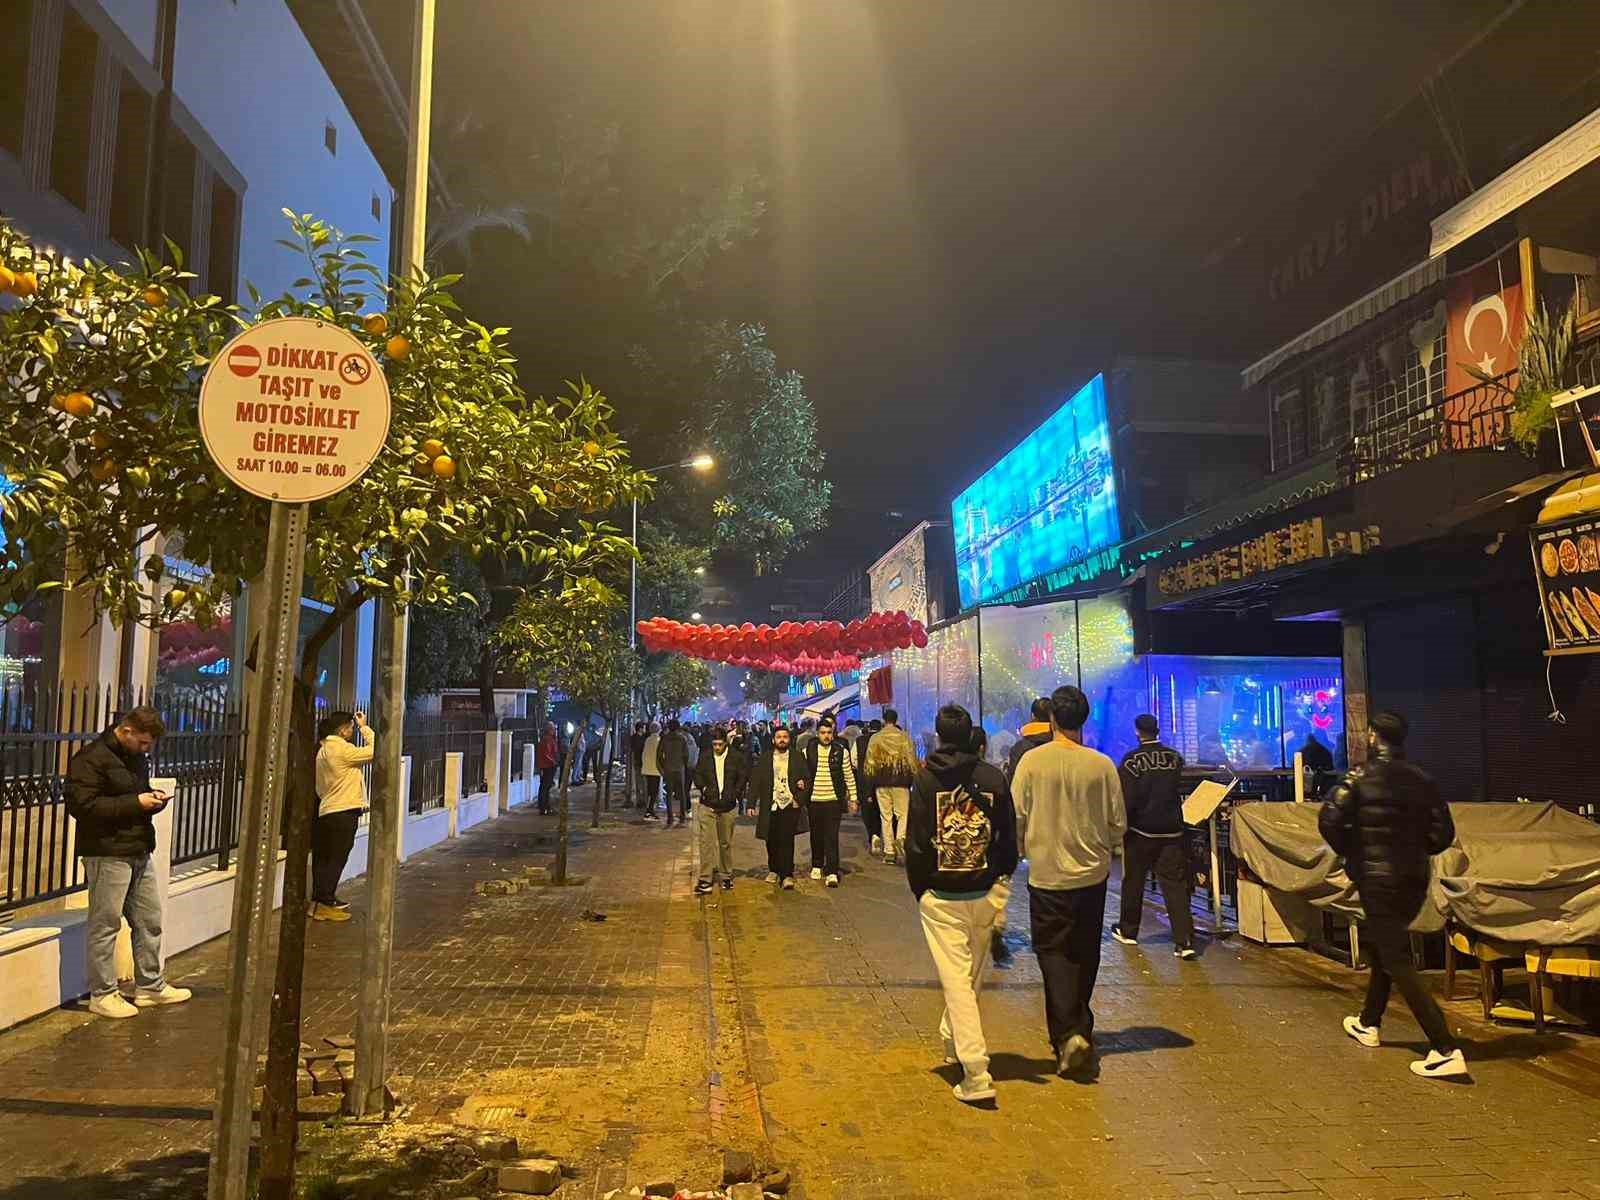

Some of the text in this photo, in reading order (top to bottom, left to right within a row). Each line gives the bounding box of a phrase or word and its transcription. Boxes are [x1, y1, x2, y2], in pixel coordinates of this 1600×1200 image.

[267, 343, 338, 371] DİKKAT
[258, 374, 341, 401] TAŞIT ve
[235, 401, 360, 430] MOTOSİKLET
[252, 428, 339, 457] GİREMEZ
[236, 457, 266, 473] SAAT
[268, 459, 299, 475] 10.00
[315, 463, 346, 477] 06.00
